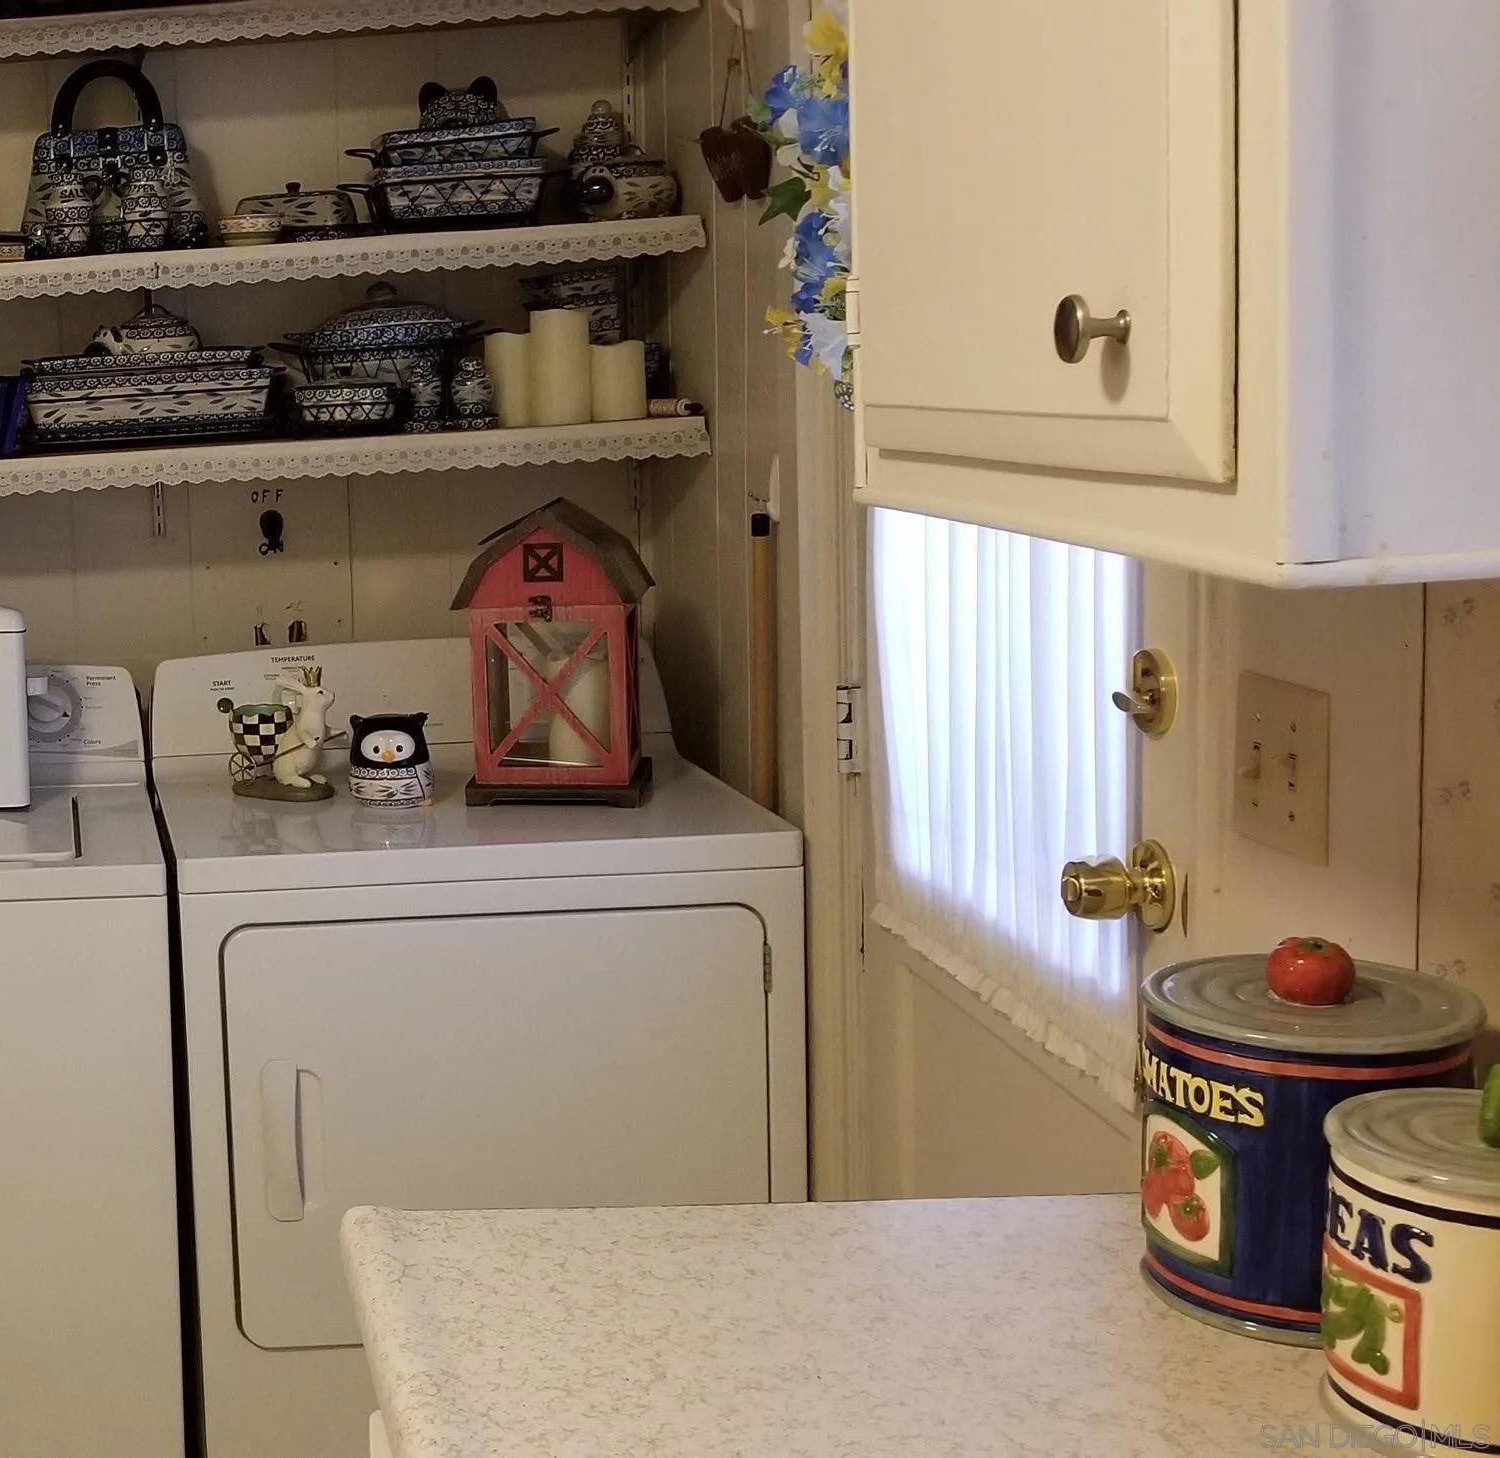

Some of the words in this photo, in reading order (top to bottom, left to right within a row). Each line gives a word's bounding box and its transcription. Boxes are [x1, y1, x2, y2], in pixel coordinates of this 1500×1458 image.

[250, 488, 284, 504] OFF
[270, 655, 316, 663] TEMPERATURE
[1143, 1047, 1265, 1128] MATOES
[1328, 1186, 1435, 1284] EAS
